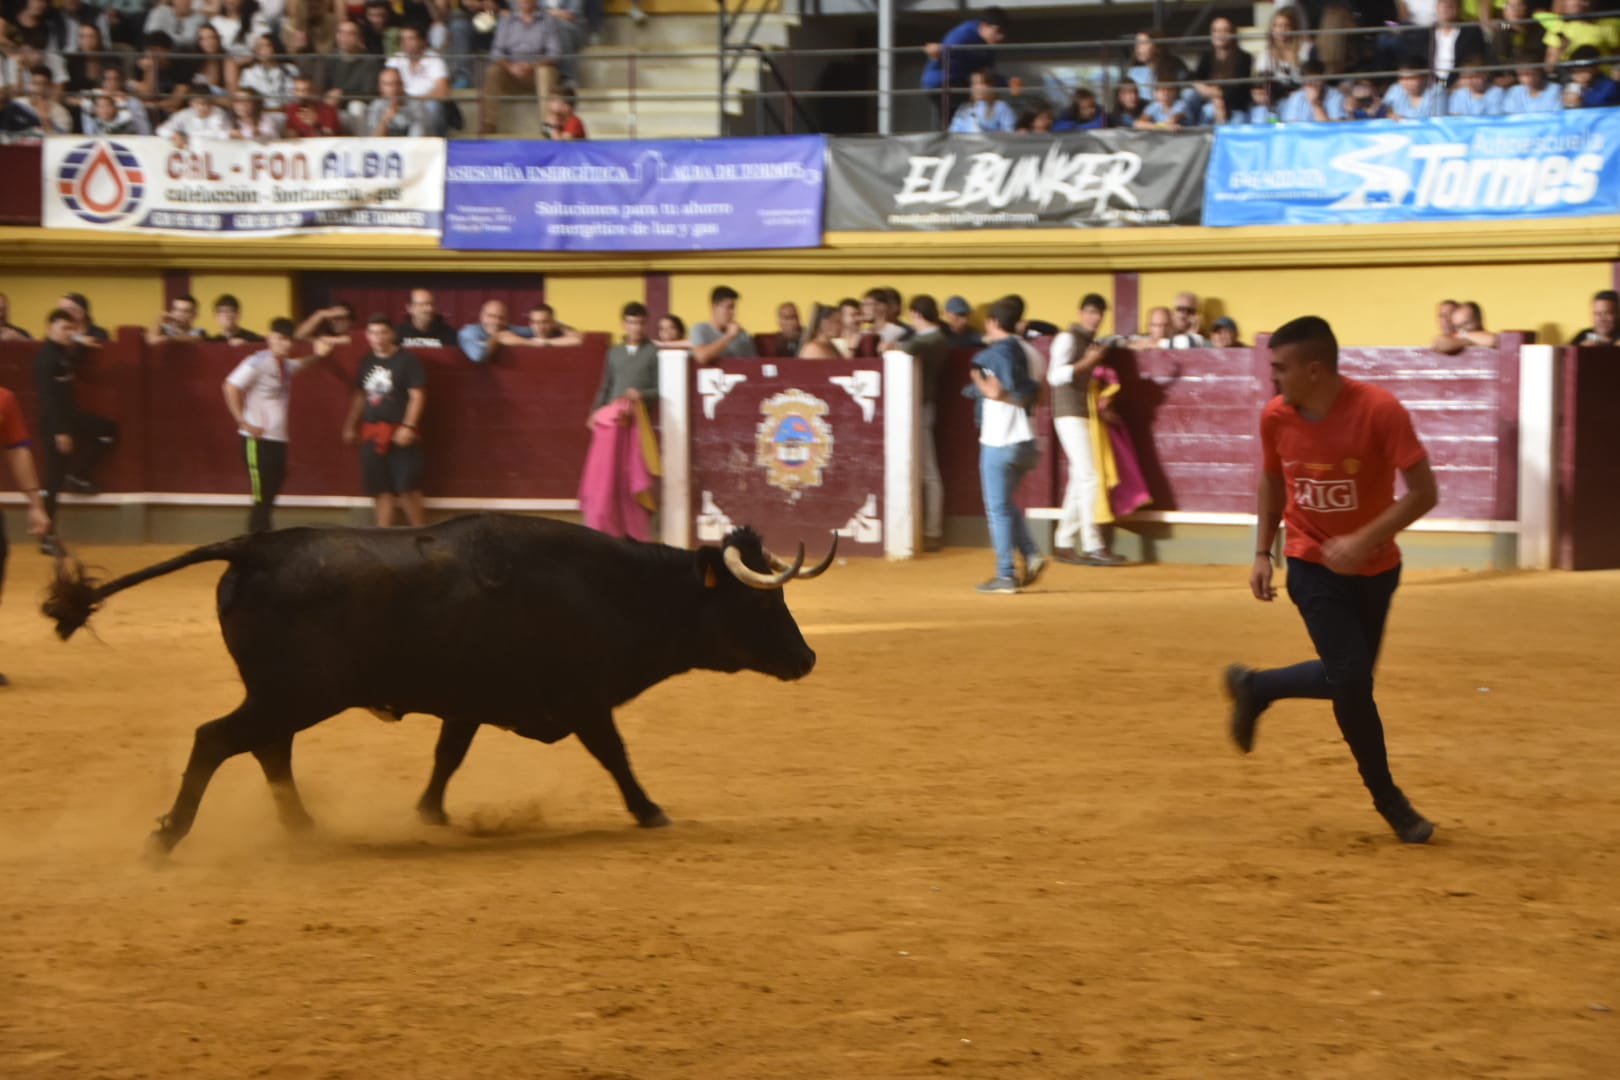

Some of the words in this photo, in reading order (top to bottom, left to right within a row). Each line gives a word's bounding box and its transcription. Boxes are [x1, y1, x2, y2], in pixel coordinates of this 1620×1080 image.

[167, 151, 221, 180] CAL
[321, 151, 404, 178] ALBA
[893, 154, 959, 206] EL
[946, 141, 1143, 213] BUNKER
[1408, 143, 1601, 208] Tormes
[534, 201, 620, 217] Soluciones
[622, 204, 659, 219] para
[681, 200, 734, 216] ahorro
